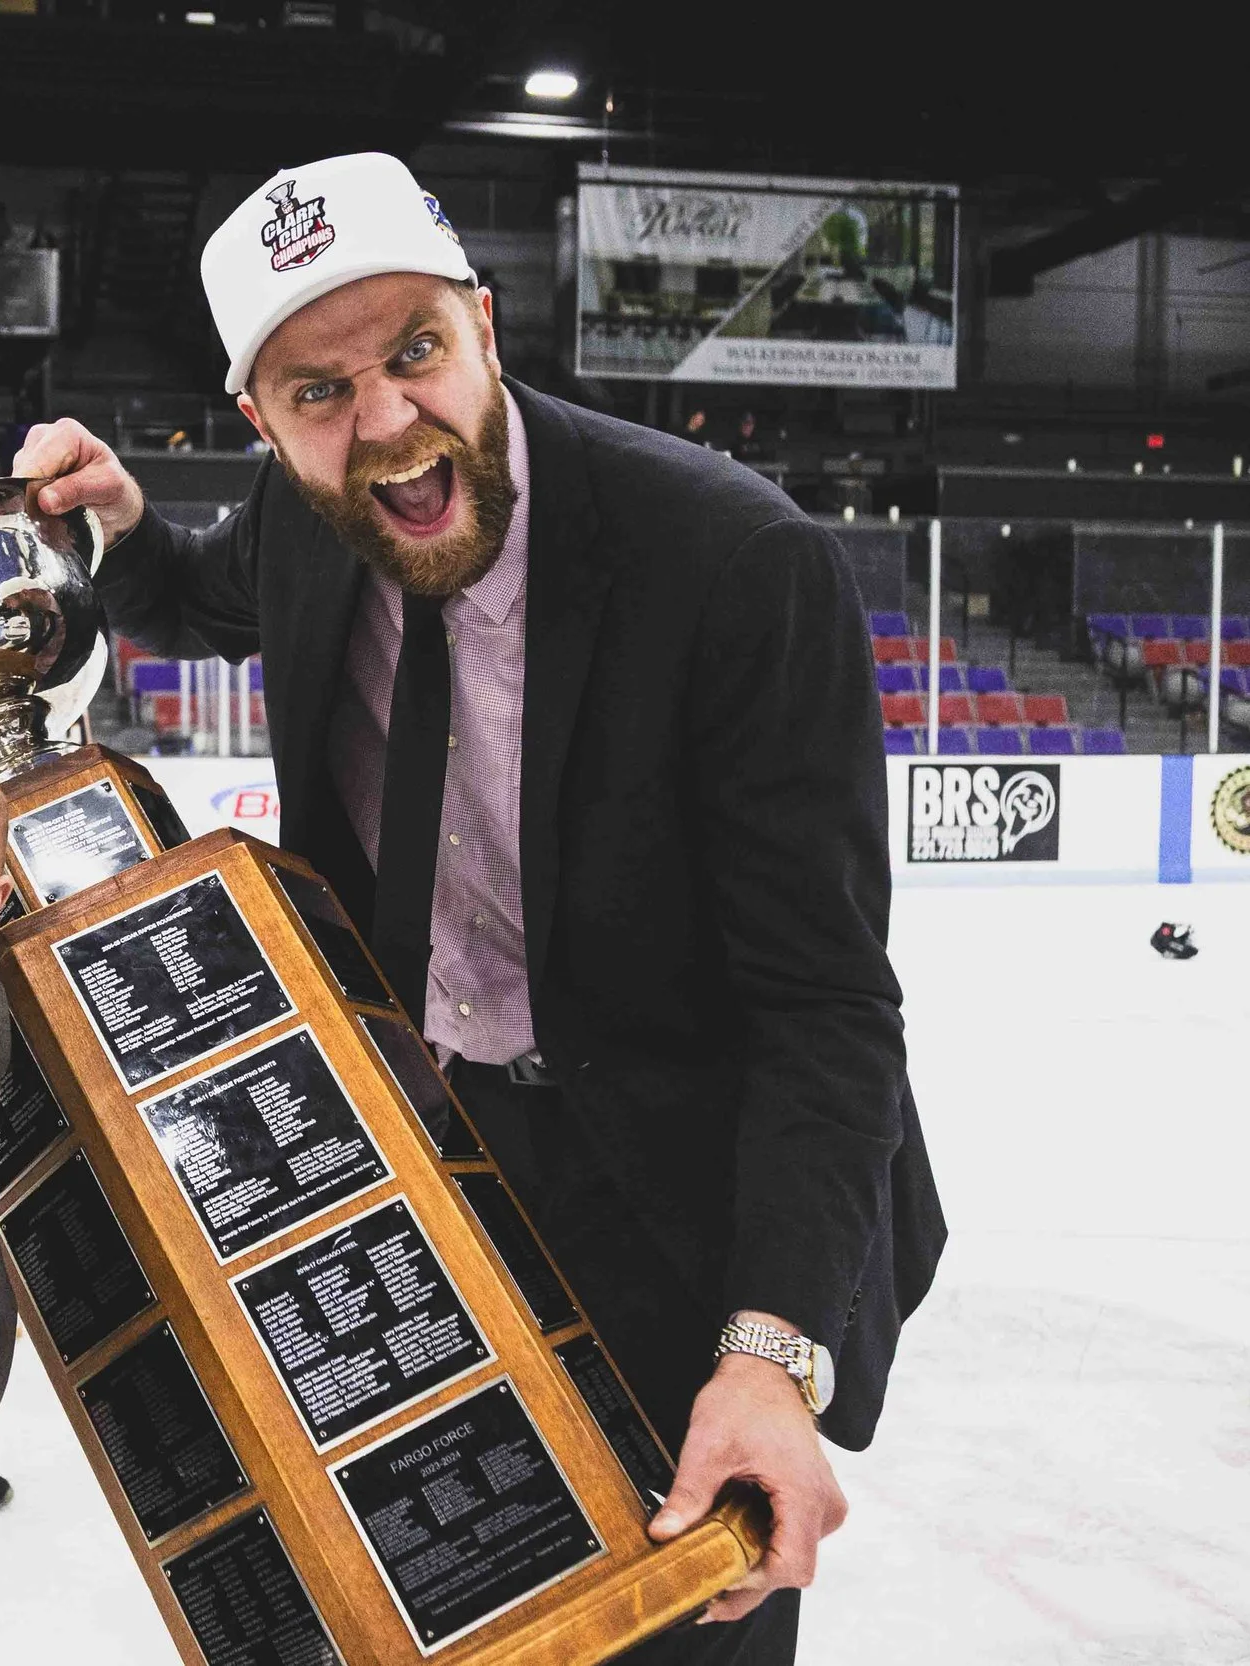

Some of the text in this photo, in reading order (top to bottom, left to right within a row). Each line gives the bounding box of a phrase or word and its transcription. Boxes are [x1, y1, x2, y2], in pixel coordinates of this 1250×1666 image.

[263, 200, 321, 243] CLARK
[278, 218, 315, 250] CUP
[272, 225, 334, 269] CHAMPIONS
[912, 765, 1001, 827] BRS
[315, 1248, 341, 1265] CHICAGO
[340, 1240, 358, 1253] STEEL
[388, 1421, 475, 1474] FARGO FORCE
[419, 1449, 462, 1477] 2023-2024
